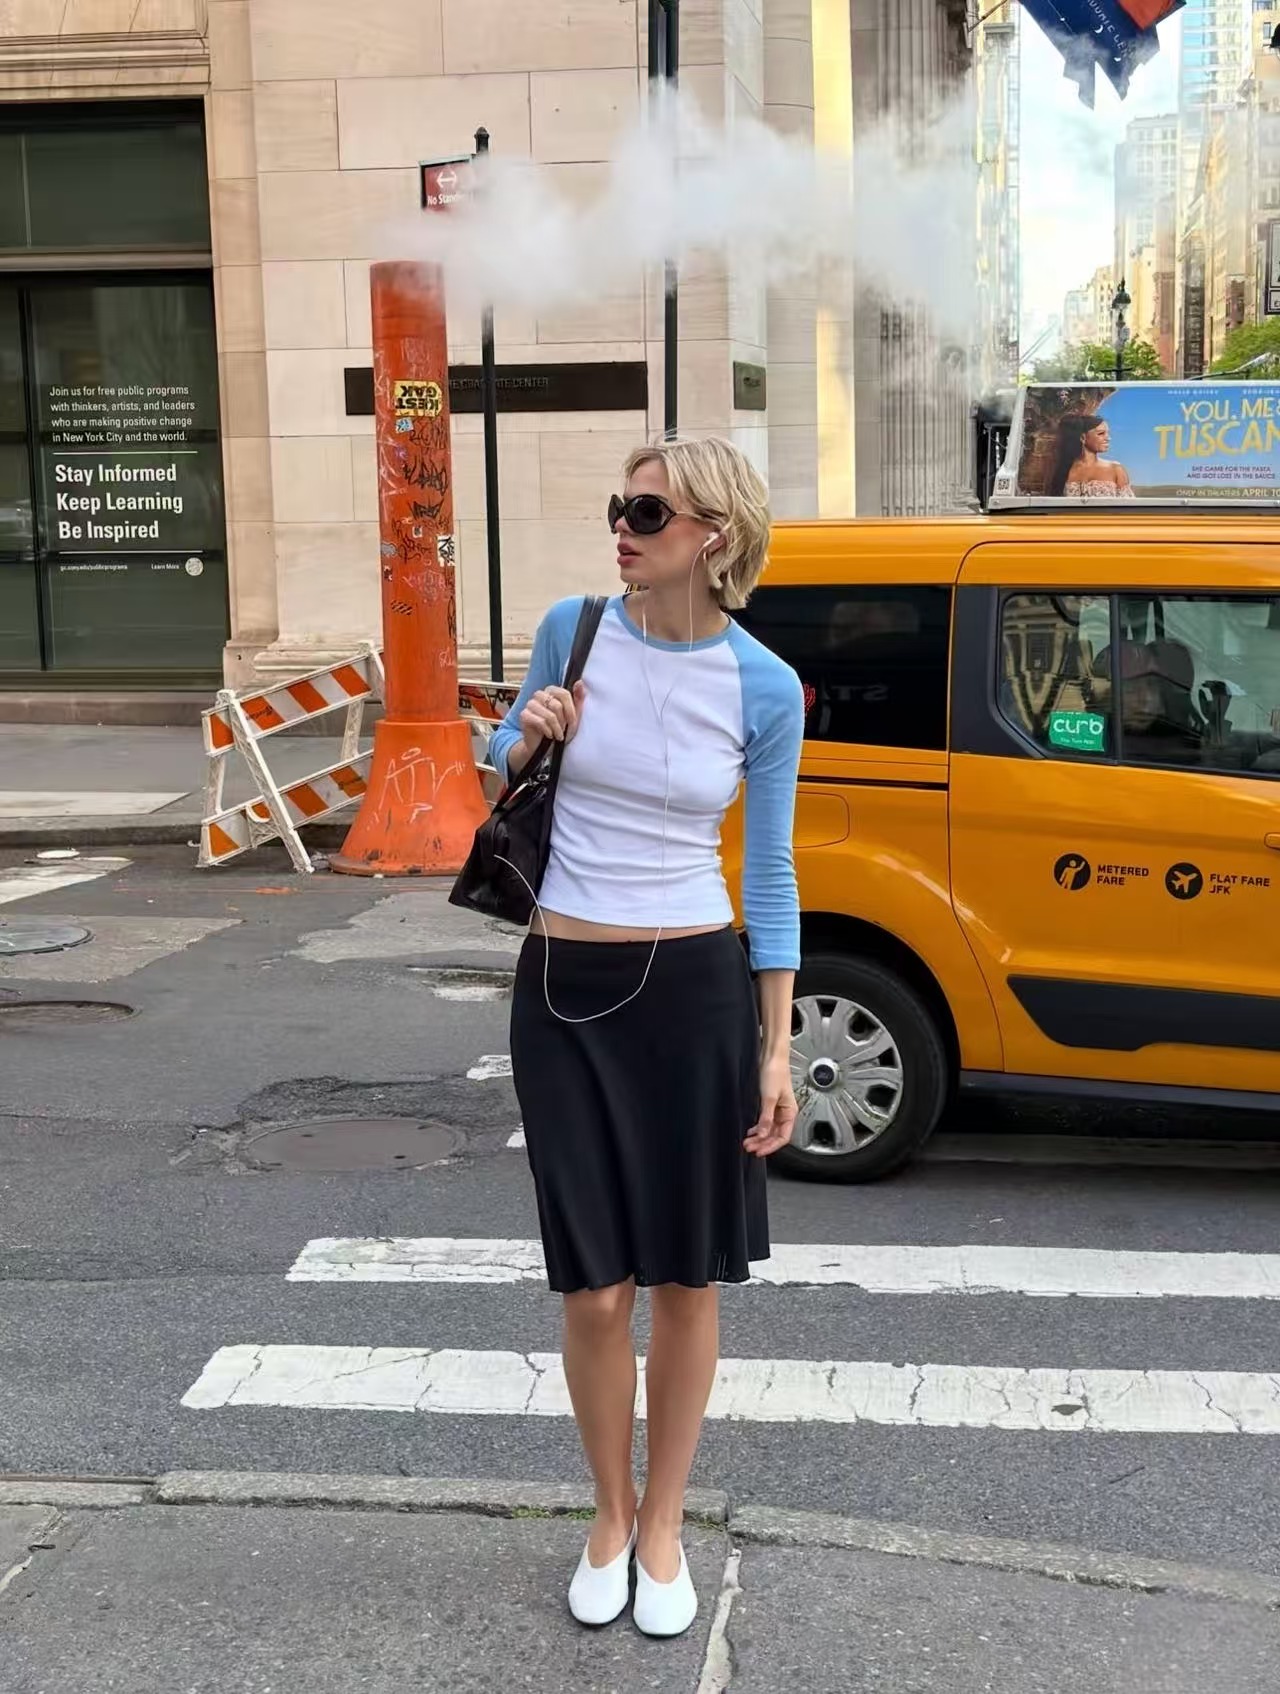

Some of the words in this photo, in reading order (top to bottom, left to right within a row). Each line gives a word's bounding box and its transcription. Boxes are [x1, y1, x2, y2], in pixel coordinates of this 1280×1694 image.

[427, 195, 437, 205] No
[50, 386, 69, 396] Join
[71, 387, 82, 396] us
[83, 386, 95, 396] for
[98, 386, 115, 395] free
[118, 386, 144, 397] public
[147, 386, 189, 397] programs
[50, 402, 70, 412] with
[72, 401, 110, 412] thinkers,
[112, 402, 142, 412] artists,
[143, 401, 160, 411] and
[162, 401, 195, 411] leaders
[52, 418, 71, 427] who
[73, 419, 87, 427] are
[89, 417, 121, 428] making
[123, 417, 157, 428] positive
[159, 417, 192, 428] change
[52, 433, 61, 442] in
[63, 433, 83, 442] New
[85, 433, 104, 442] York
[106, 432, 123, 444] City
[125, 432, 142, 442] and
[143, 432, 158, 442] the
[160, 431, 188, 442] world.
[55, 464, 93, 486] Stay
[98, 463, 177, 482] Informed
[1241, 489, 1269, 497] APRIL
[56, 492, 101, 515] Keep
[106, 491, 183, 514] Learning
[58, 521, 82, 539] Be
[87, 520, 159, 543] Inspired
[1053, 718, 1103, 735] curb
[1097, 864, 1149, 877] METERED
[1096, 875, 1125, 886] FARE
[1209, 873, 1238, 884] FLAT
[1240, 875, 1270, 887] FARE
[1208, 884, 1231, 895] JFK
